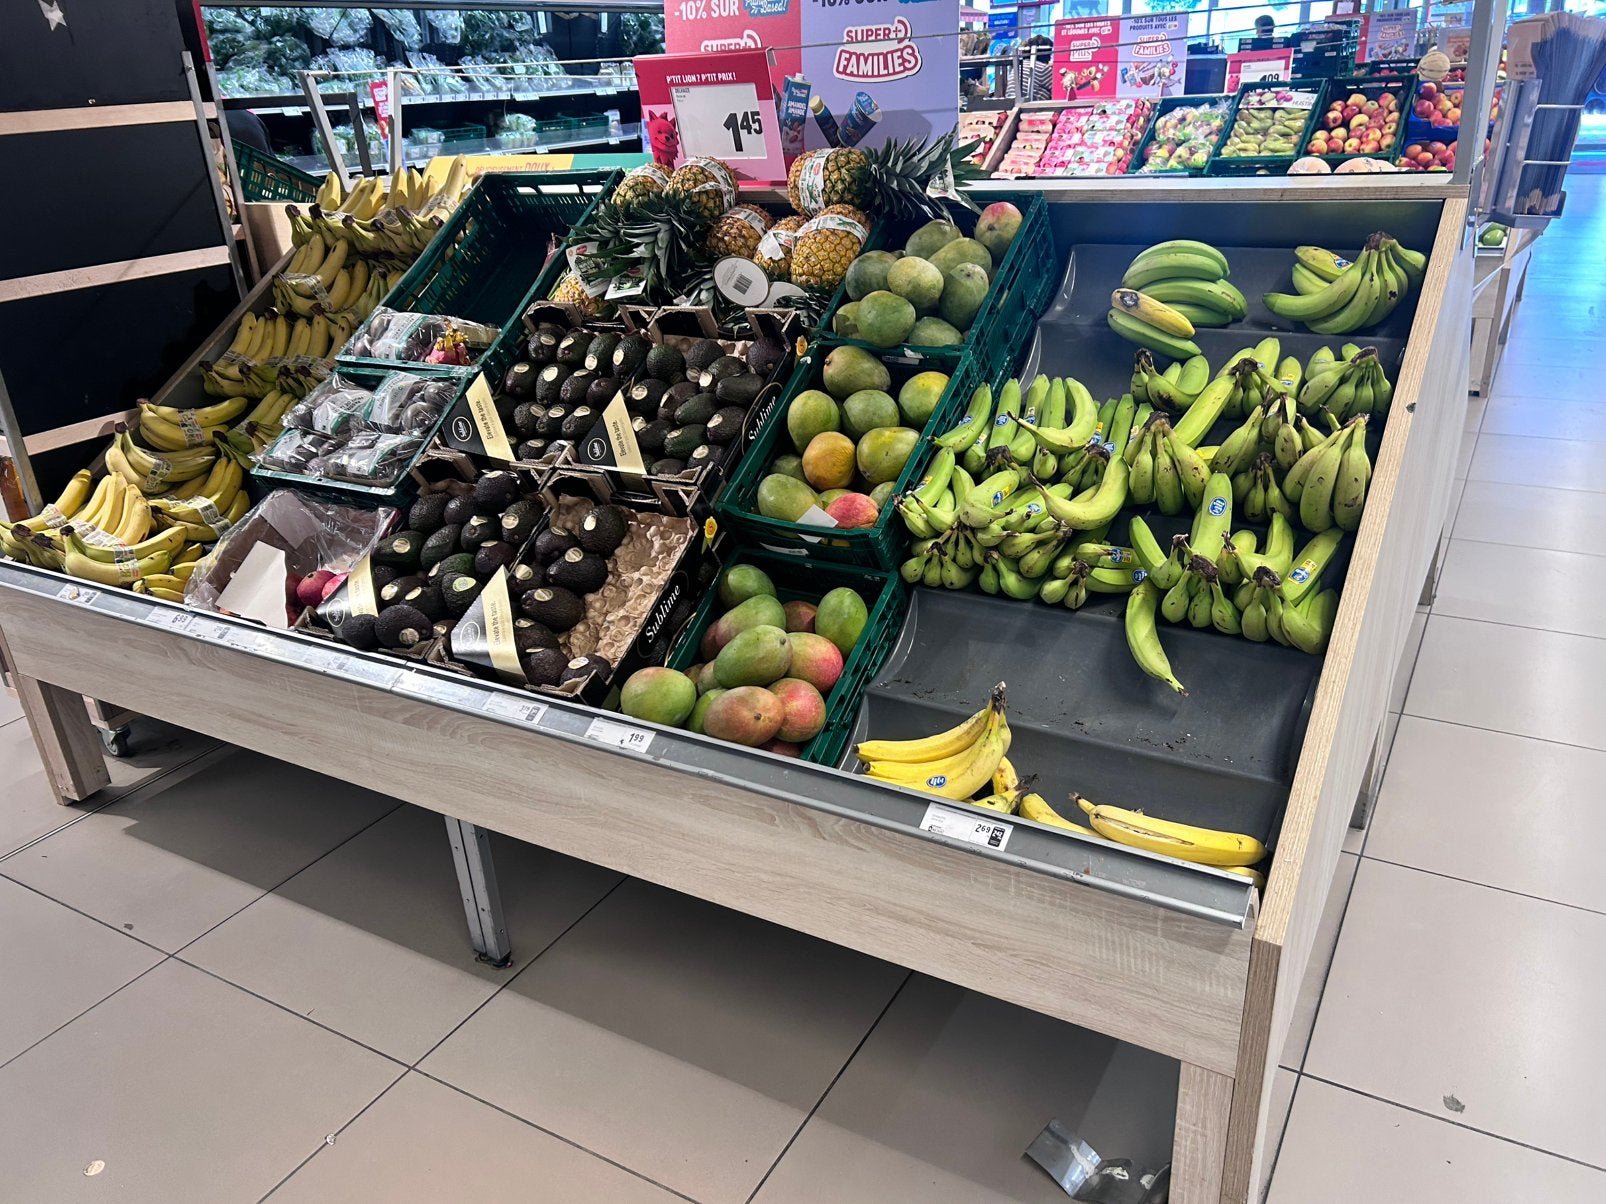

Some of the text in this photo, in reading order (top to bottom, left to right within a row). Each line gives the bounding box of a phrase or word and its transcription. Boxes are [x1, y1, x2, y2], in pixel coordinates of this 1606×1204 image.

[674, 0, 707, 20] -10%
[839, 48, 916, 77] FAMILIES
[748, 396, 776, 441] Sublime
[483, 422, 494, 440] Elevate
[615, 432, 623, 441] the
[617, 441, 627, 457] Elevate
[645, 585, 681, 643] Sublime
